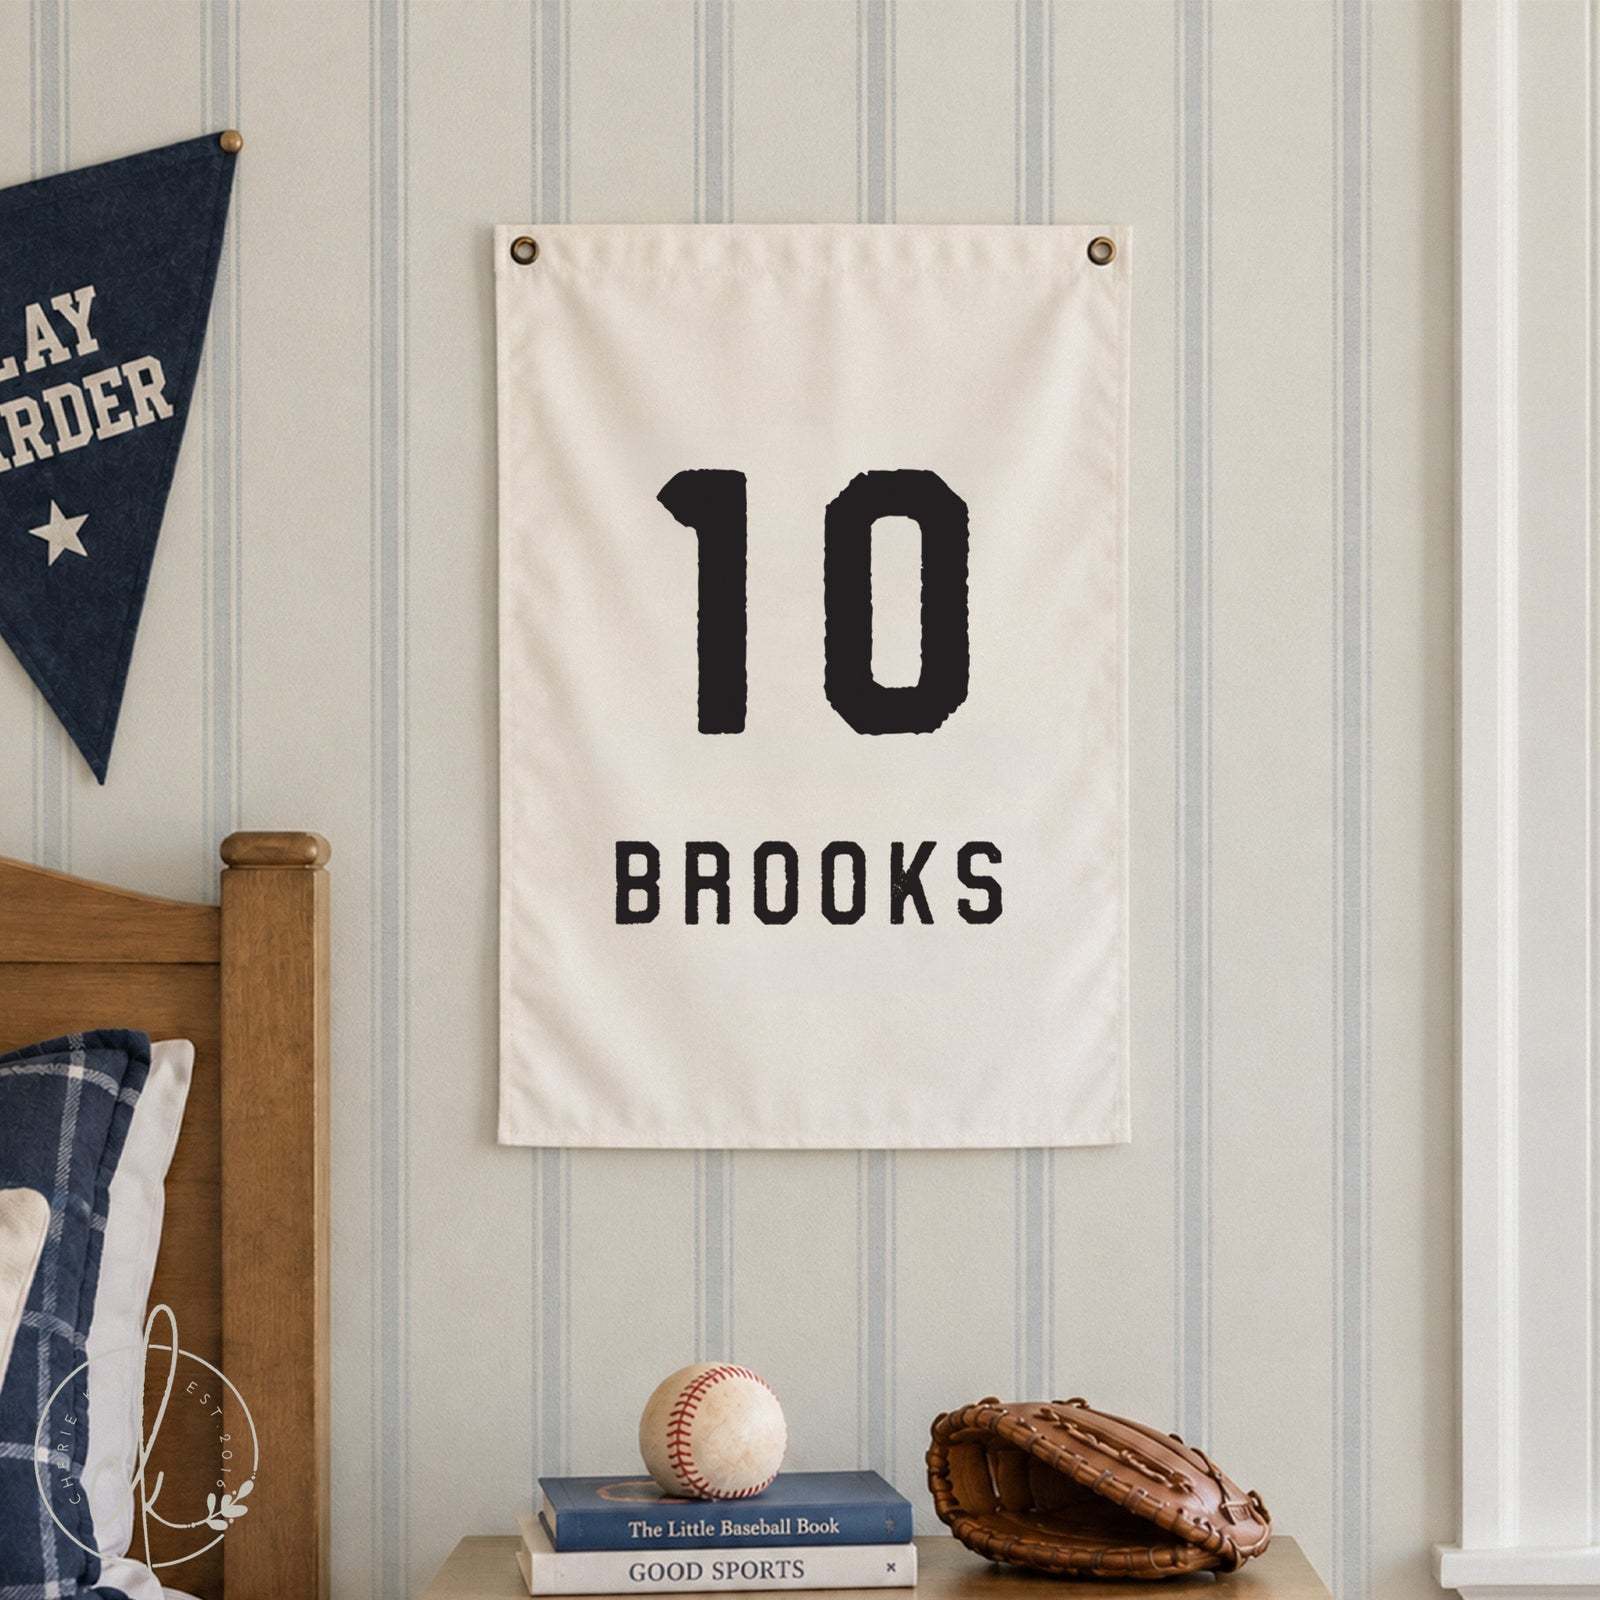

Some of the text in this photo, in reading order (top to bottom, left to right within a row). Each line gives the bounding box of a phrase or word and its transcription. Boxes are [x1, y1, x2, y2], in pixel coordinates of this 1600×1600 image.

[0, 355, 174, 473] RDER
[656, 468, 970, 735] 10
[615, 840, 1004, 926] BROOKS
[628, 1517, 840, 1538] The Little Baseball Book
[629, 1560, 805, 1582] GOOD SPORTS
